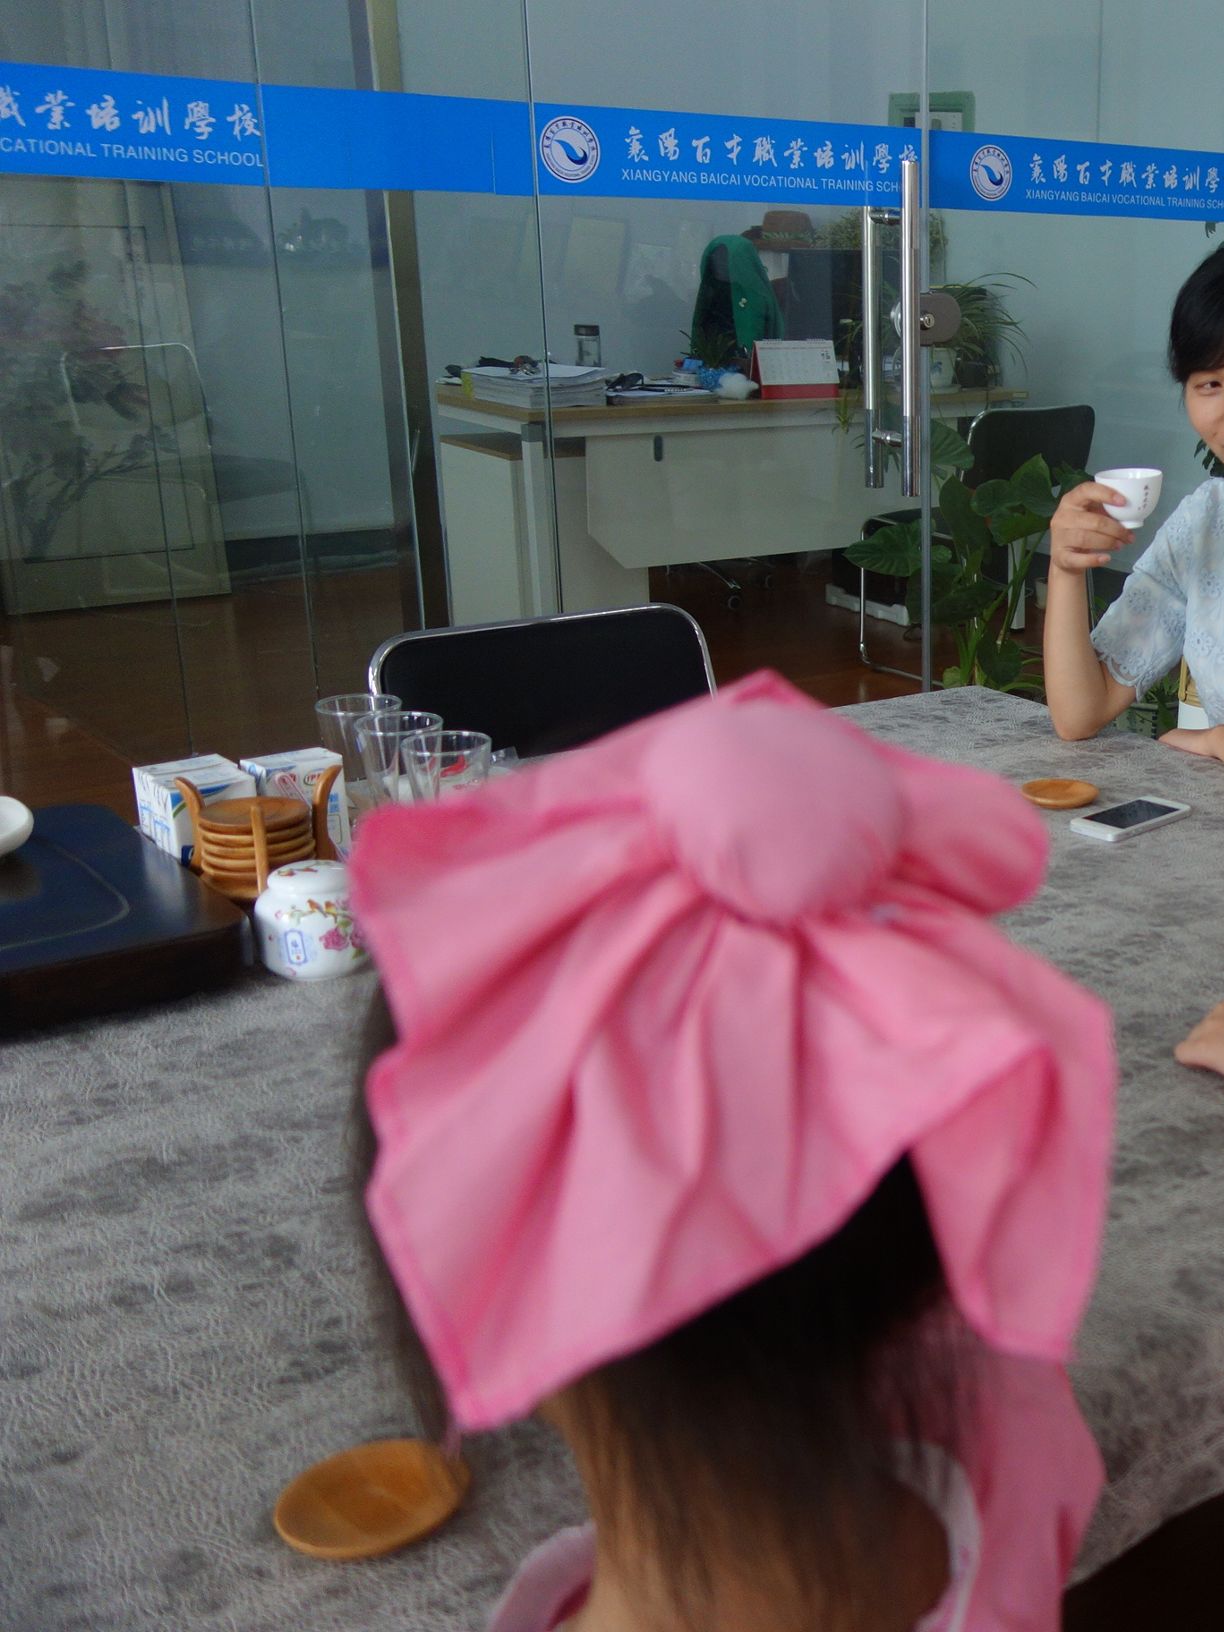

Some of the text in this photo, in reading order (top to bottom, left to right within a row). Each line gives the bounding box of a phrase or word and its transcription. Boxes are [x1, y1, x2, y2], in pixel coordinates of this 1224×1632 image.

[100, 144, 188, 163] TRAINING
[192, 150, 265, 167] SCHOOL
[621, 168, 902, 193] XIANGYANG BAICAI VOCATIONAL TRAINING SCH
[1025, 188, 1080, 202] XIANGYANG
[1080, 192, 1111, 203] BAICAI
[1112, 194, 1165, 207] VOCATIONAL
[1166, 197, 1206, 209] TRAINING
